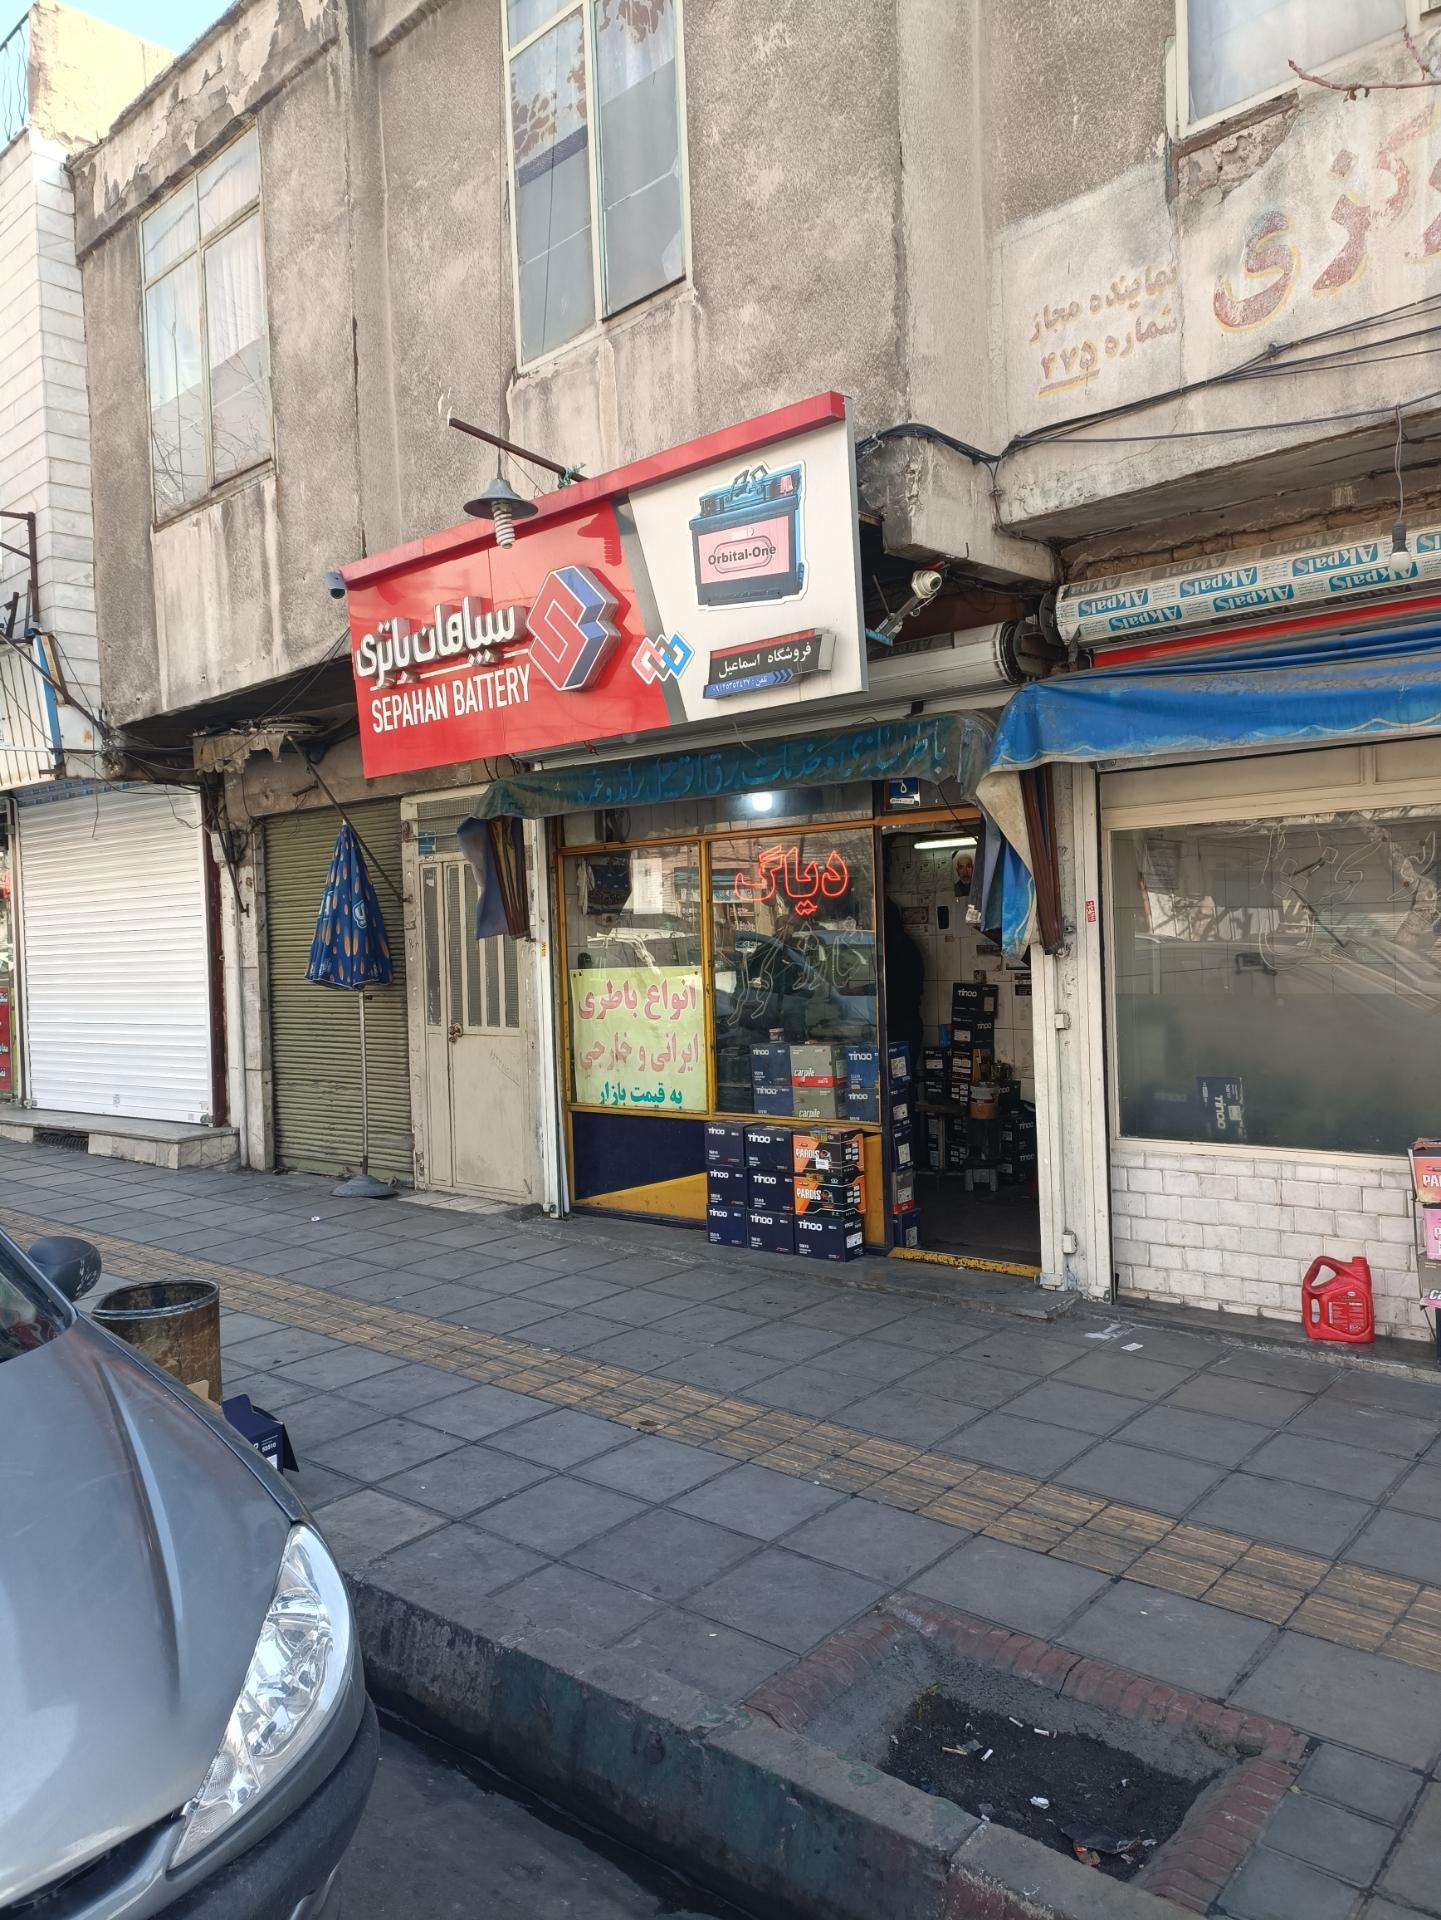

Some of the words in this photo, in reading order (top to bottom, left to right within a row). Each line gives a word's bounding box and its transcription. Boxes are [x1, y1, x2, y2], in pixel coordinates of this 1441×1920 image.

[1104, 303, 1178, 359] شماره
[708, 545, 777, 566] Orbital-One
[413, 596, 516, 665] سپاهان
[356, 617, 411, 689] باتری
[718, 653, 761, 679] اسماعیل
[767, 641, 812, 663] فروشگاه
[371, 683, 449, 733] SEPAHAN
[452, 663, 531, 716] BATTERY
[734, 843, 849, 917] دیاگ
[578, 978, 638, 1020] باطری
[644, 978, 698, 1021] انواع
[579, 1031, 632, 1074] خارجی
[637, 1045, 646, 1072] و
[650, 1031, 700, 1074] ایرانی
[599, 1080, 627, 1106] بازار
[630, 1082, 666, 1108] قیمت
[669, 1088, 683, 1109] به
[796, 1187, 822, 1201] PARDIS
